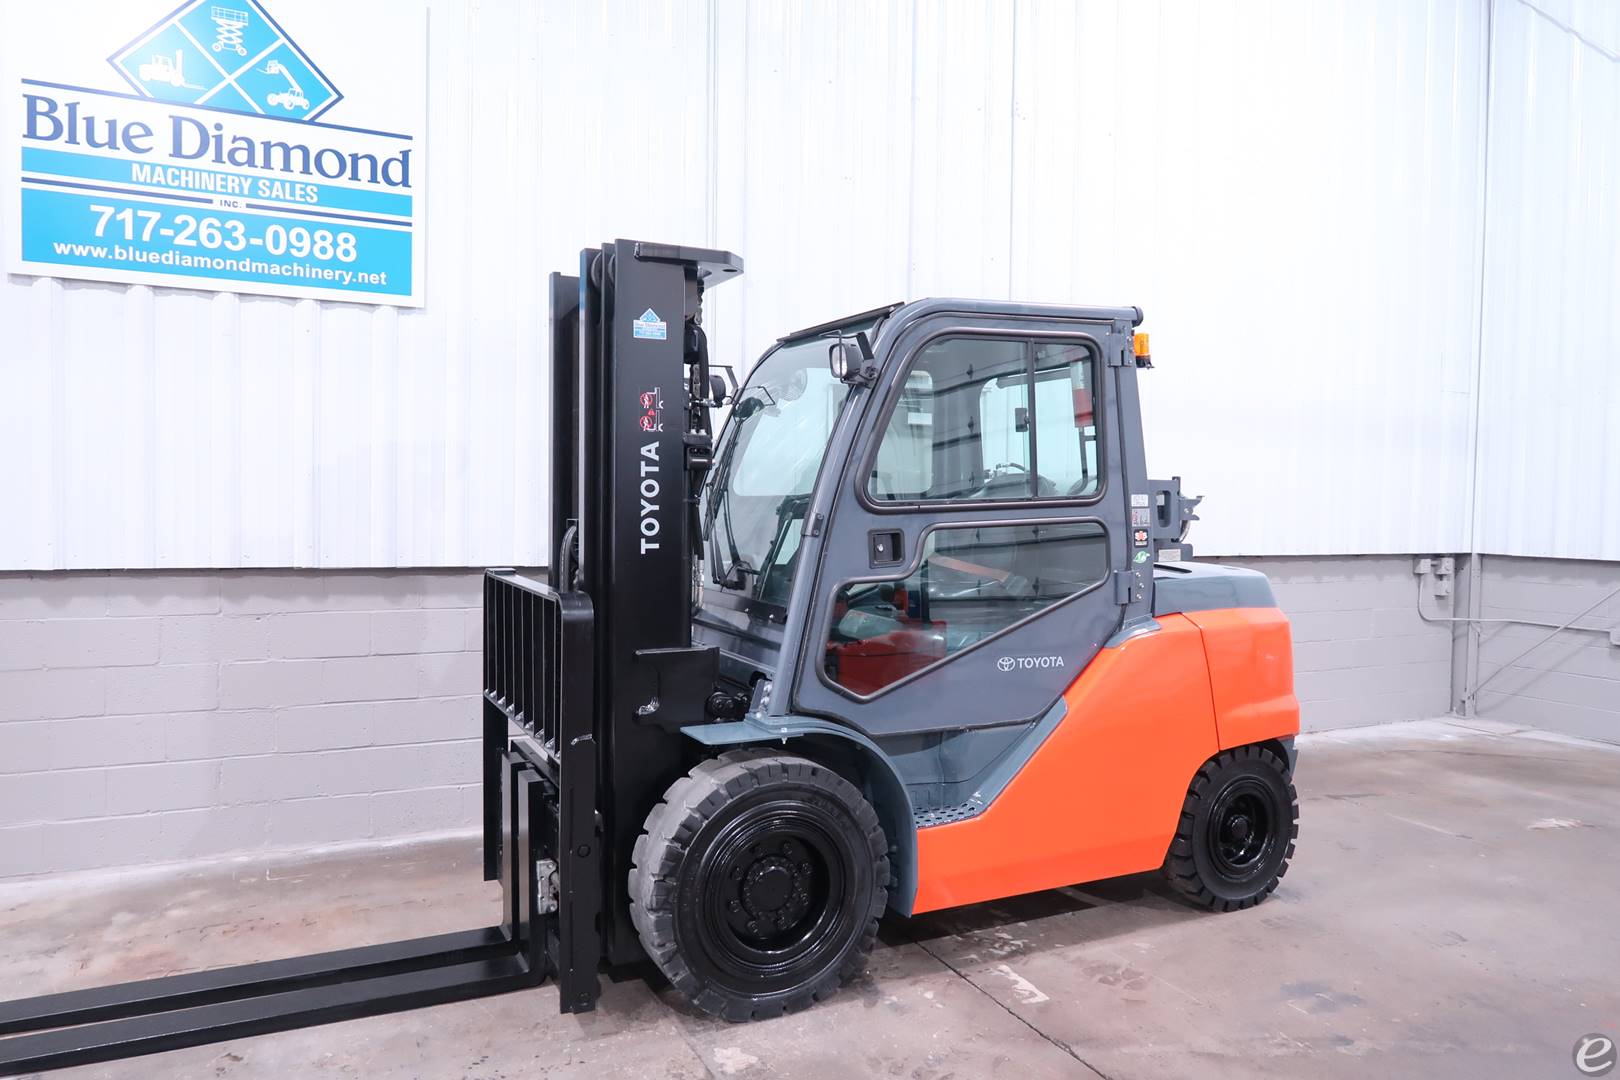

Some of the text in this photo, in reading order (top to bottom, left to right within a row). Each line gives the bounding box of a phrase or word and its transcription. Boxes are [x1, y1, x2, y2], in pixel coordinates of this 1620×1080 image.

[22, 93, 412, 188] Blue Diamond
[131, 163, 319, 203] MACHINERY SALES
[219, 199, 242, 209] INC.
[89, 204, 358, 263] 717-263-0988
[53, 239, 388, 286] www.bluediamondmachinery.net
[640, 441, 660, 554] TOYOTA
[1017, 656, 1065, 669] TOYOTA
